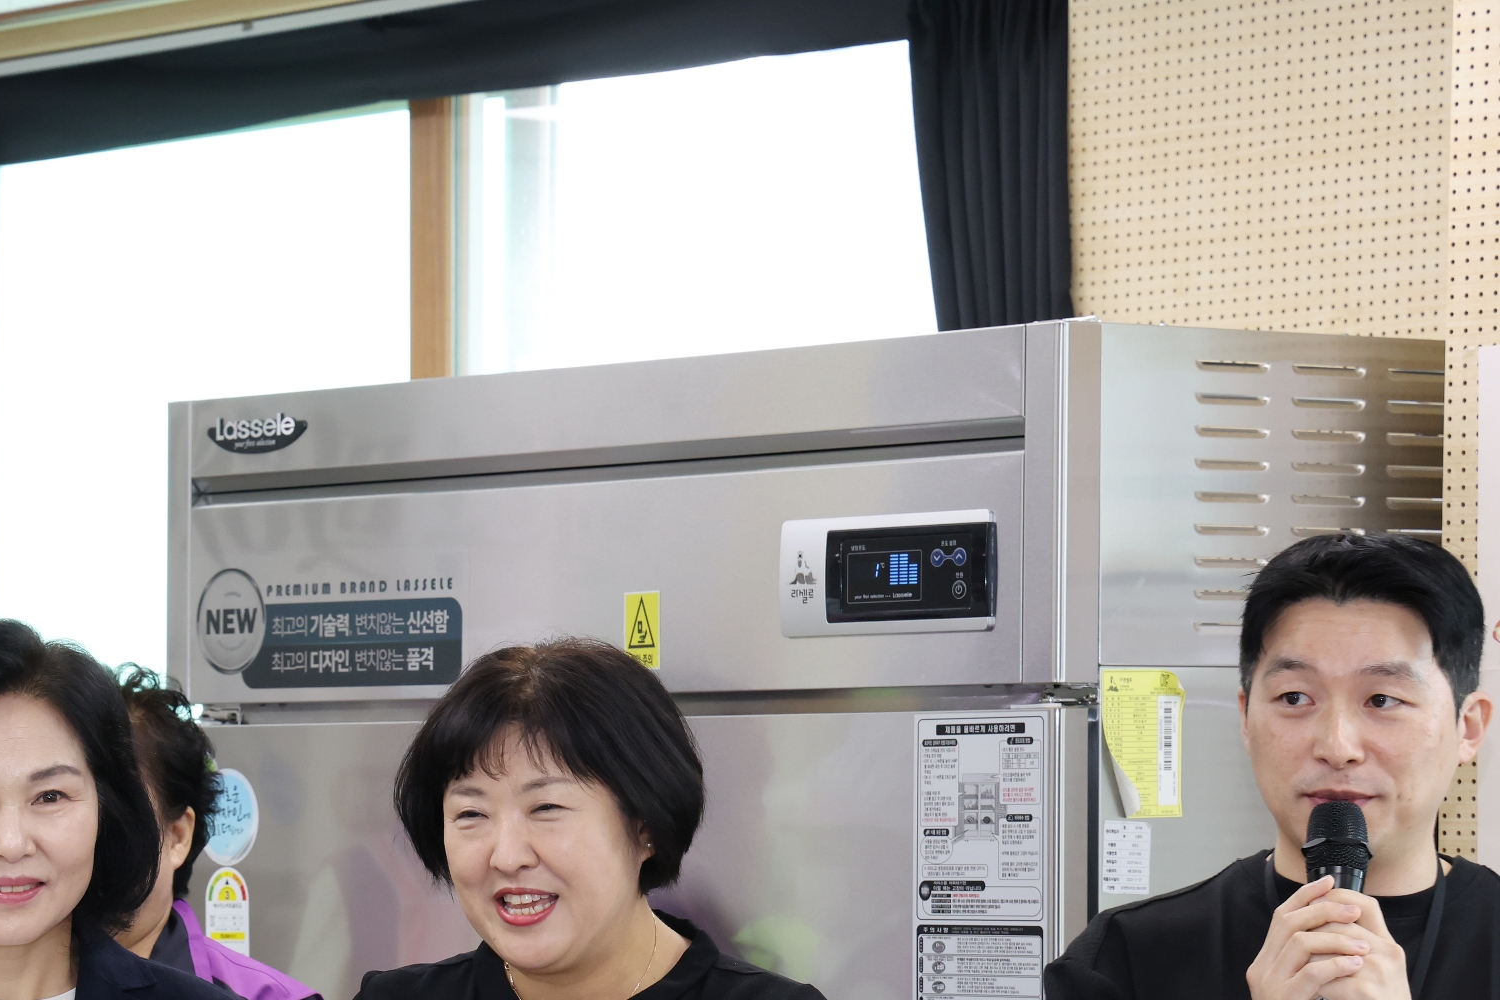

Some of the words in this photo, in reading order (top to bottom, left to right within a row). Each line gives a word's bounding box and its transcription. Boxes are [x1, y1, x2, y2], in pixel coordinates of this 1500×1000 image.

[215, 412, 296, 442] Lassele
[266, 583, 331, 597] PREMIUM
[340, 580, 388, 594] BRAND
[396, 578, 453, 592] LASSELE
[206, 608, 257, 635] NEW
[272, 614, 309, 638] 최고의
[355, 612, 405, 636] 변치않는
[407, 610, 449, 635] 신선함
[271, 651, 309, 674] 최고의
[355, 648, 405, 672] 변치않는
[406, 646, 434, 671] 품격
